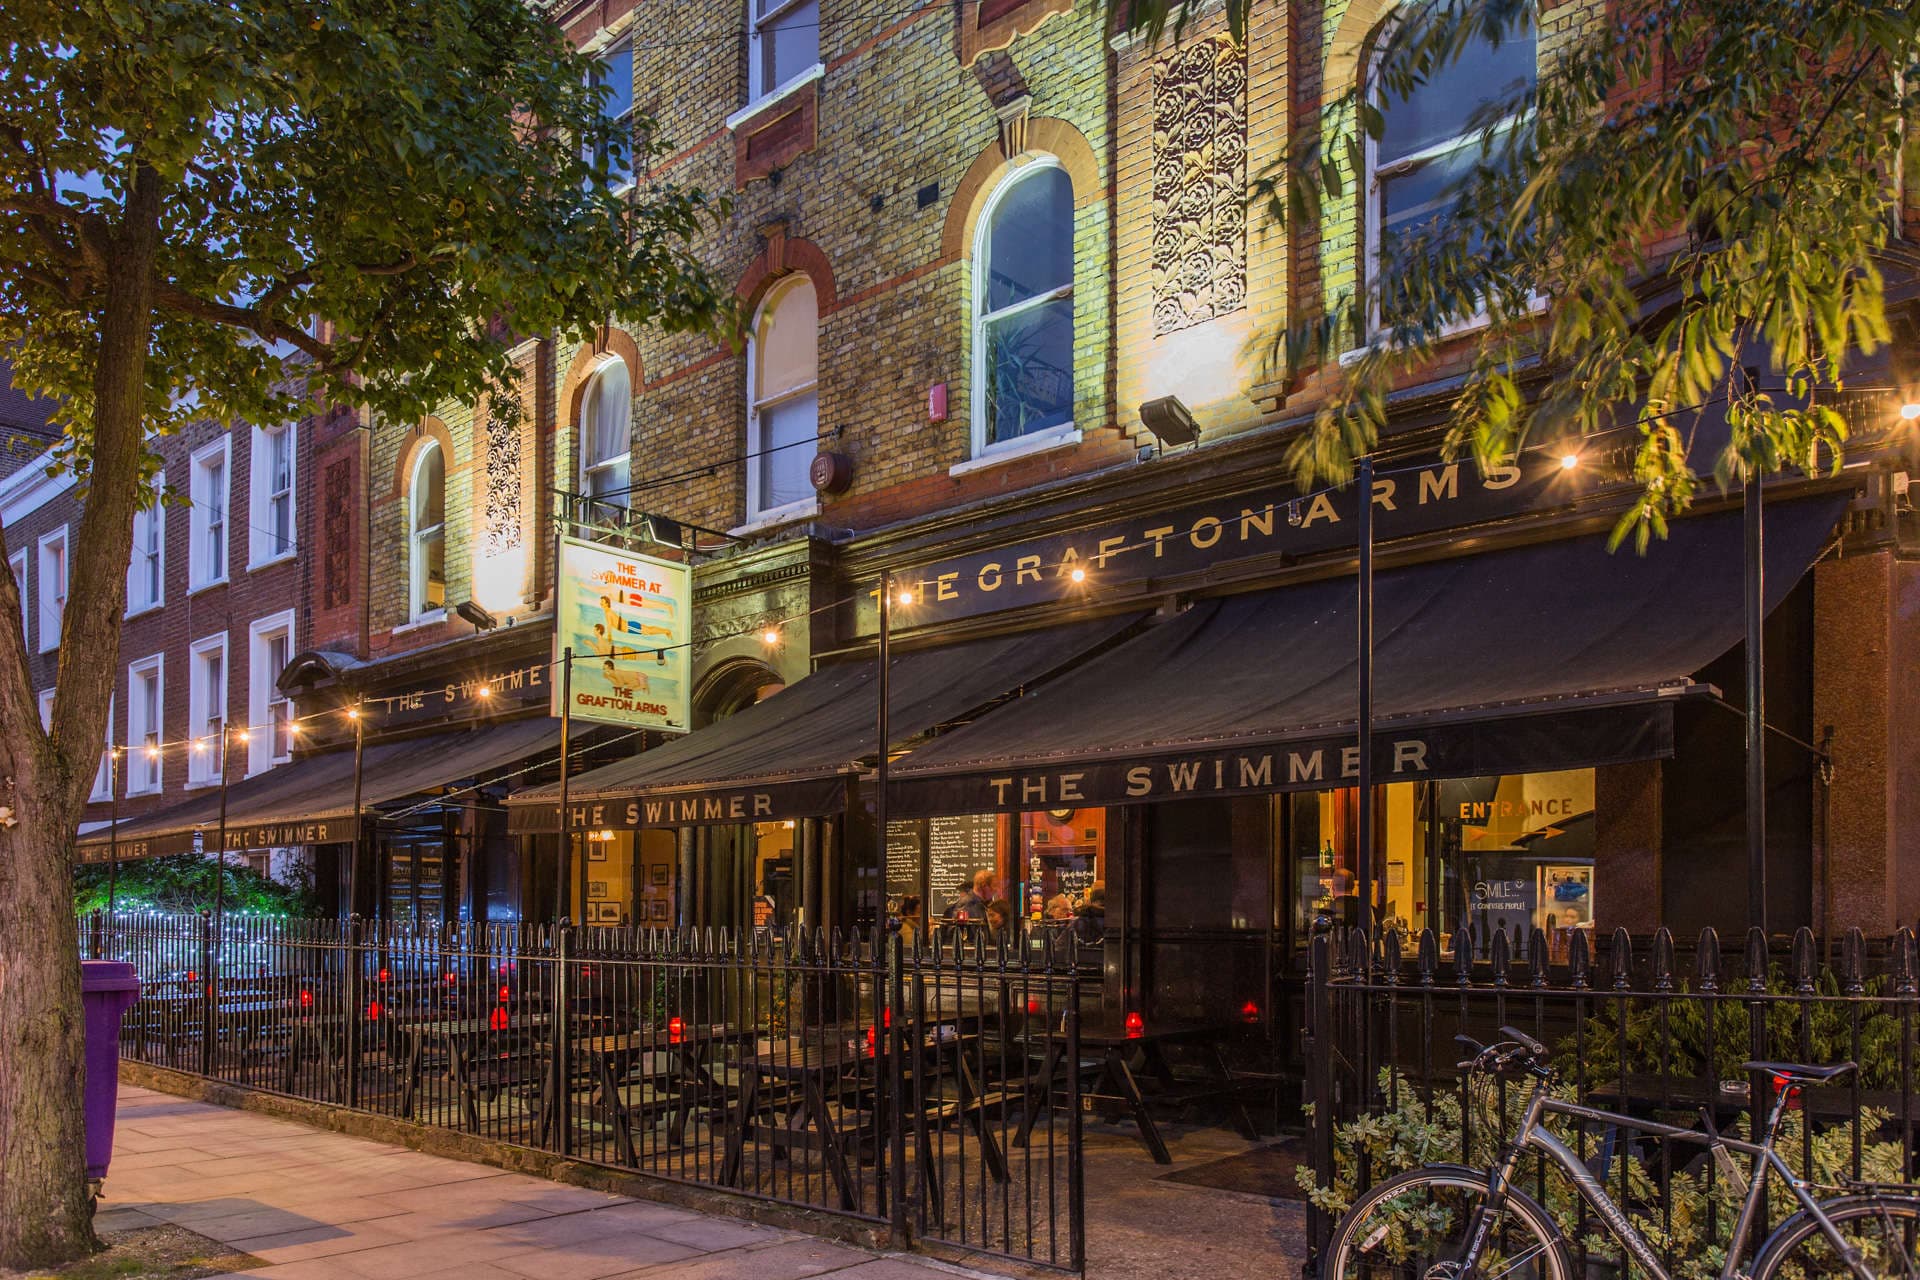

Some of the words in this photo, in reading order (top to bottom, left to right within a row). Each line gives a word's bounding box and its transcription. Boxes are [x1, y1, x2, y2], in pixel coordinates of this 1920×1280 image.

[977, 504, 1274, 592] GRAFTON
[1300, 453, 1522, 529] ARMS
[616, 561, 637, 576] THE
[592, 569, 646, 591] SWIMMER
[649, 581, 662, 594] AT
[386, 690, 424, 714] THE
[577, 693, 632, 711] GRAFTON
[635, 702, 667, 716] ARMS
[613, 686, 633, 699] THE
[990, 773, 1084, 805] THE
[1126, 740, 1428, 796] SWIMMER
[626, 794, 773, 825] SWIMMER
[1460, 798, 1572, 819] ENTRANCE
[225, 831, 249, 849] THE
[258, 824, 328, 846] SWIMMER
[102, 842, 148, 860] SIMMER
